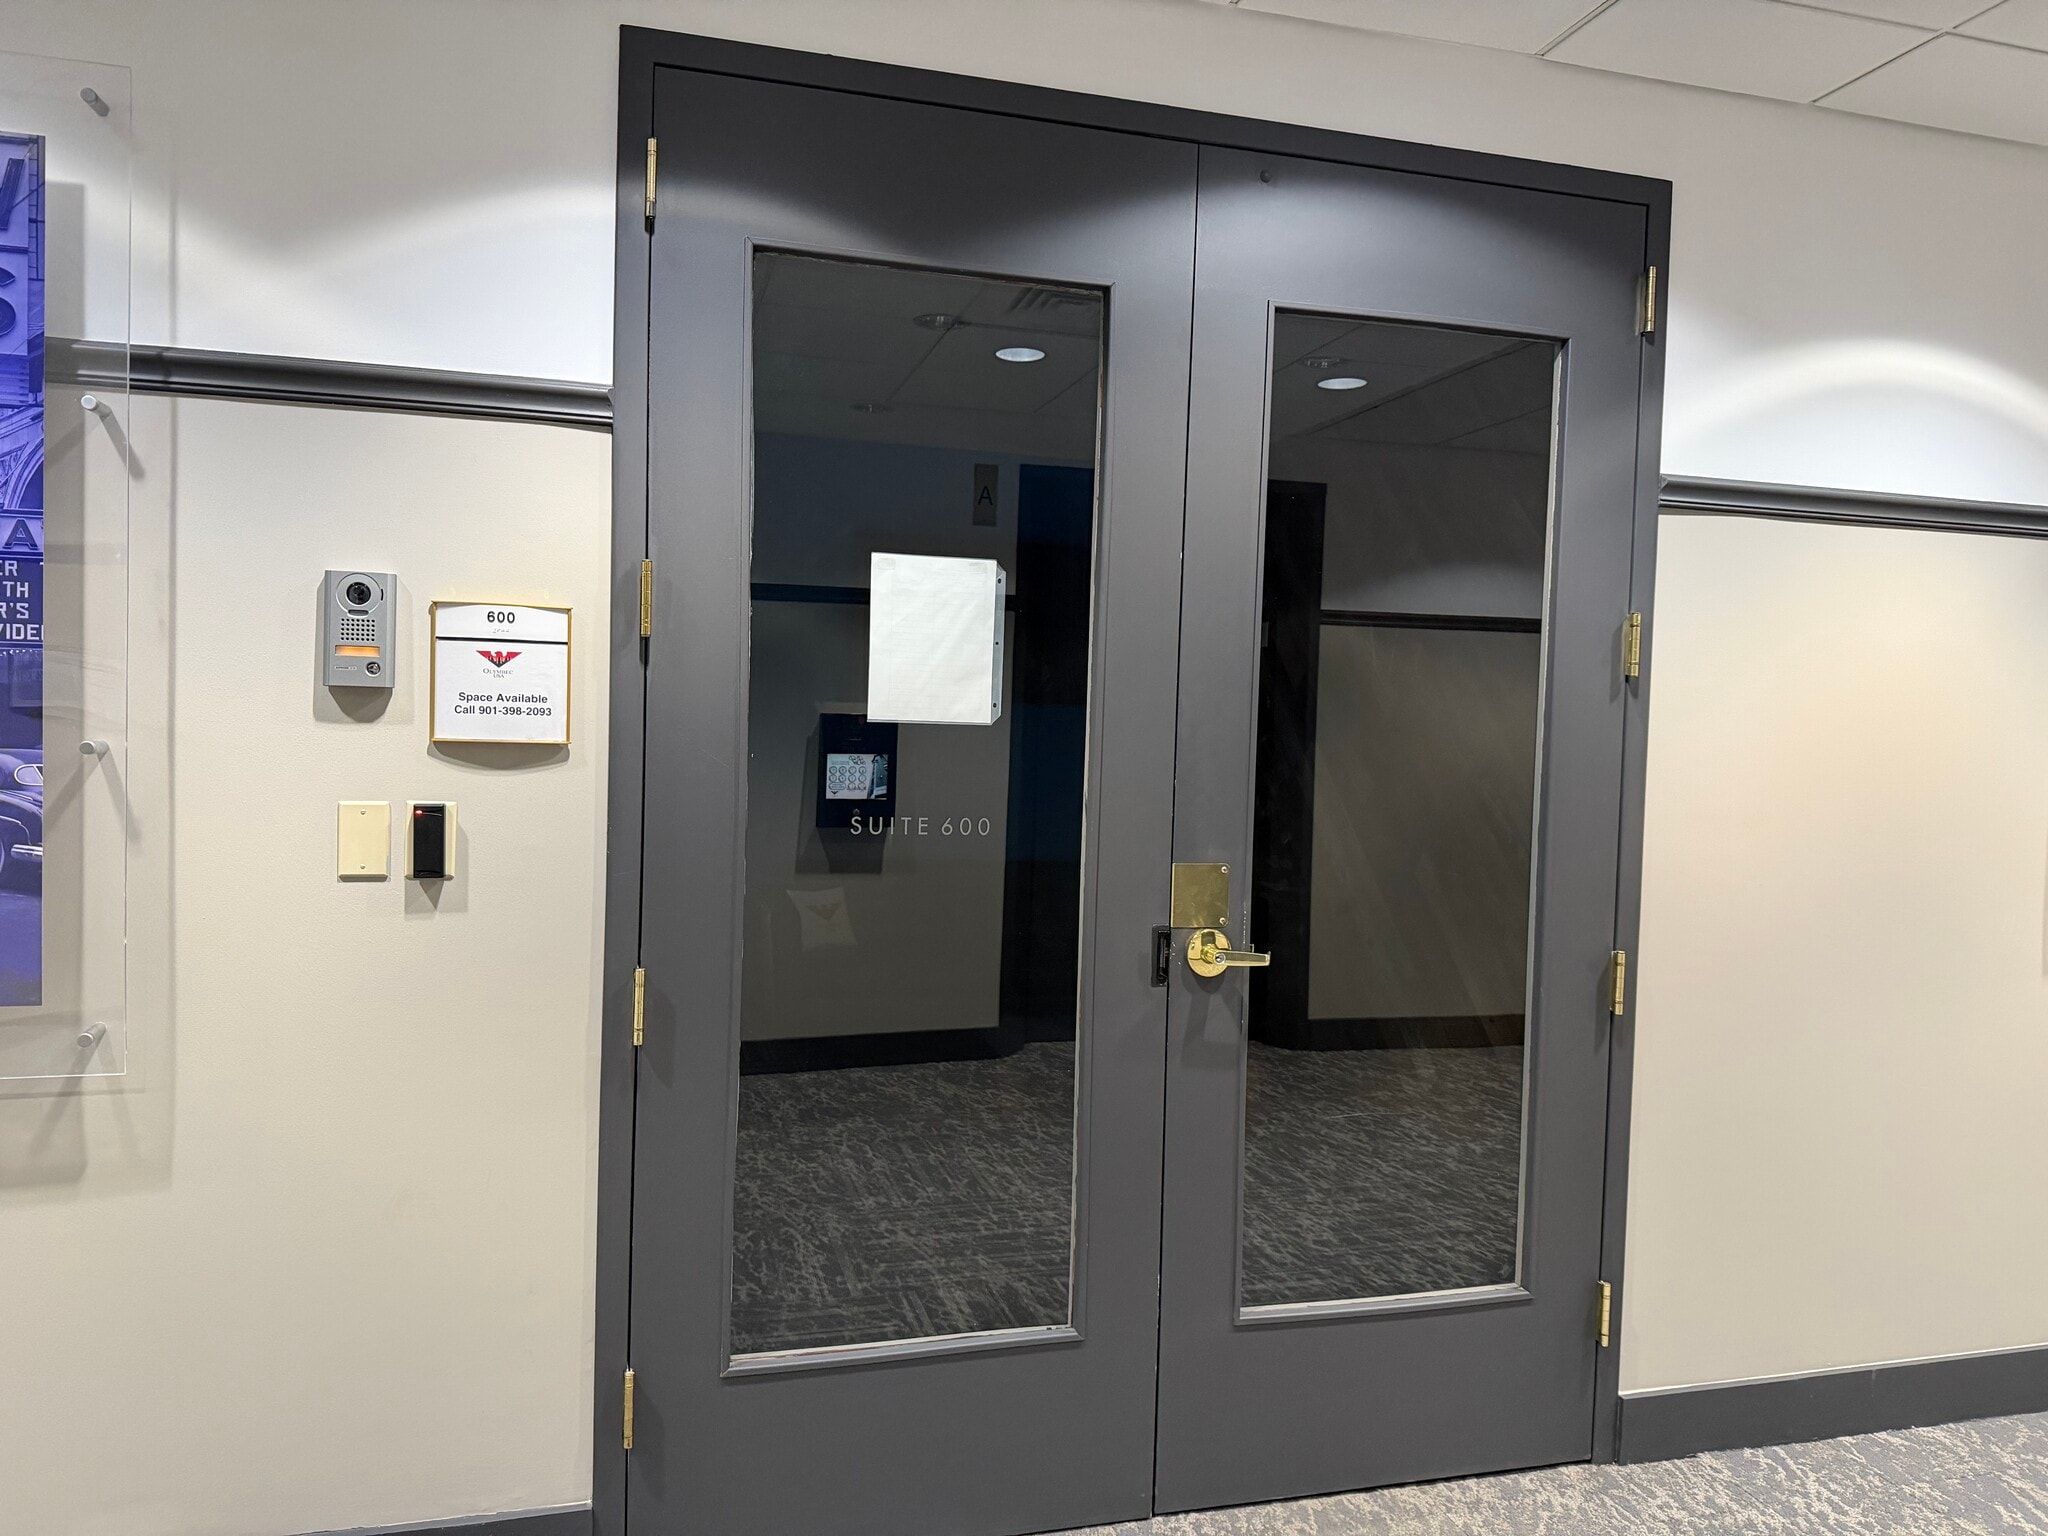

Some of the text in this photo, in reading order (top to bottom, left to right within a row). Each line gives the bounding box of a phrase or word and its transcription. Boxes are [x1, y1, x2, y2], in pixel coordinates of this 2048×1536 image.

[977, 485, 993, 506] A
[0, 560, 18, 576] R
[487, 610, 516, 624] 600
[0, 623, 44, 641] IDE
[458, 692, 548, 704] Space Available
[454, 705, 552, 717] Call 901-398-2093
[850, 816, 991, 836] SUITE 600
